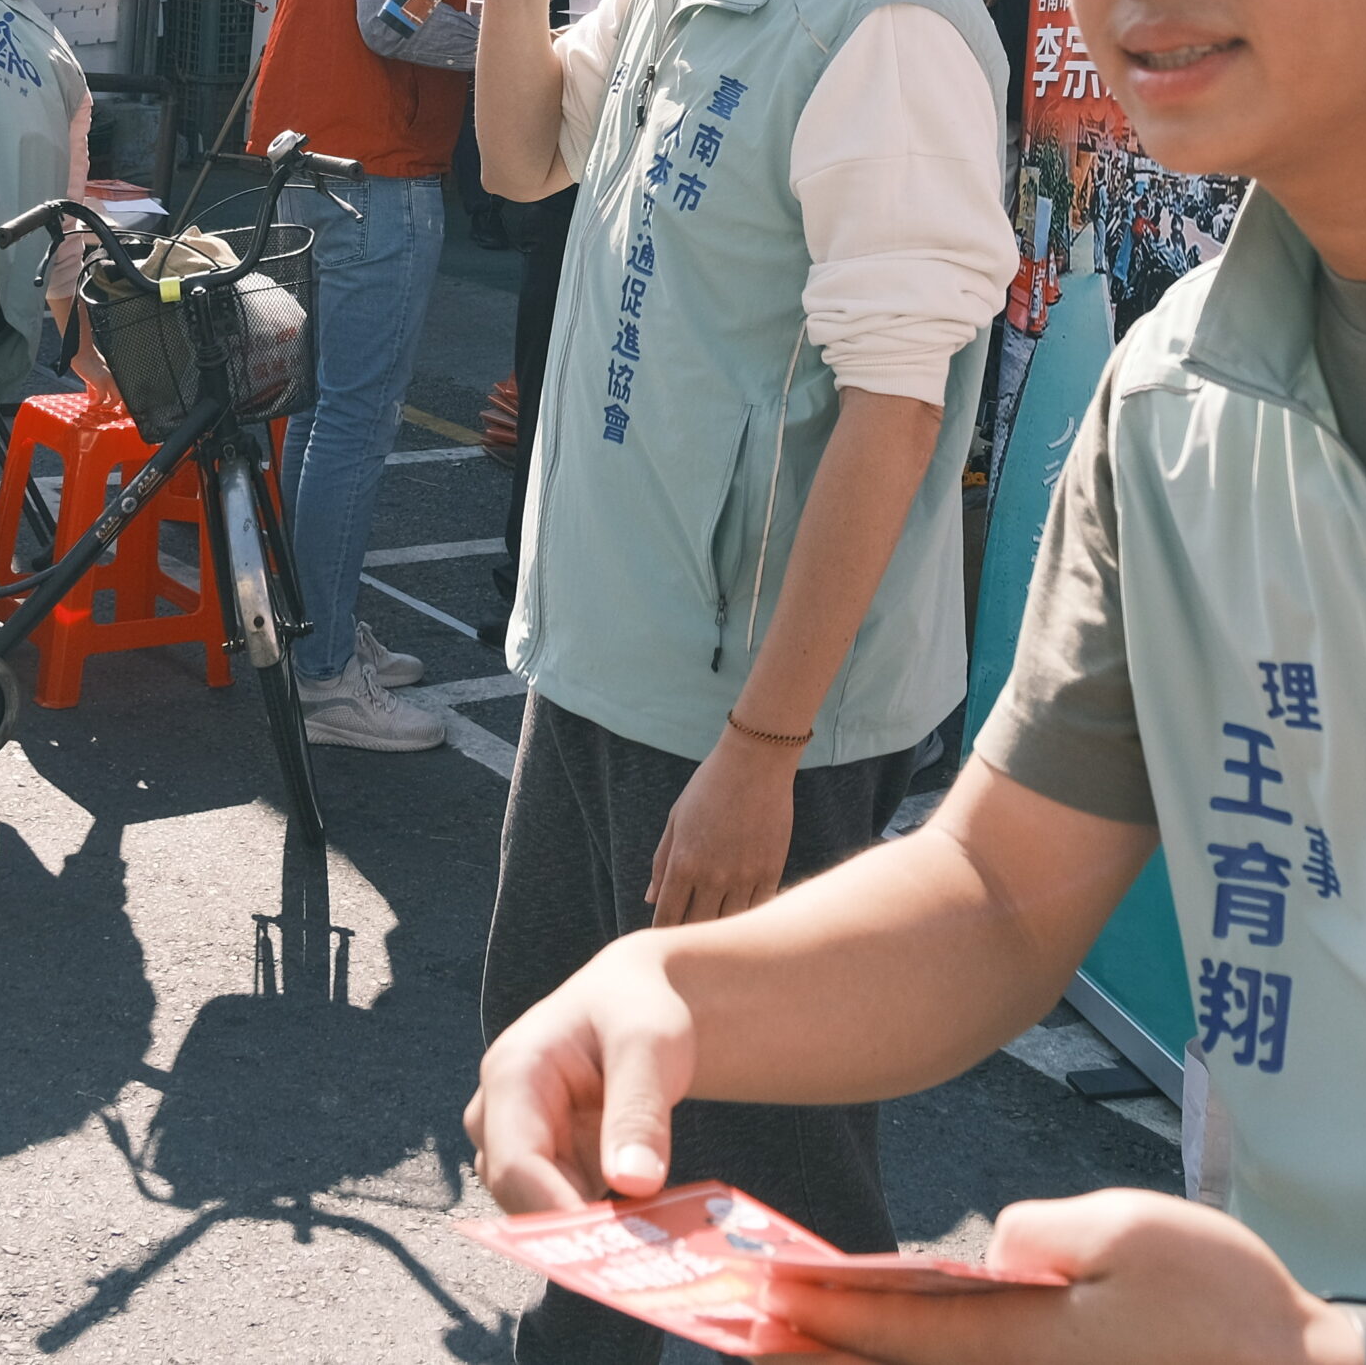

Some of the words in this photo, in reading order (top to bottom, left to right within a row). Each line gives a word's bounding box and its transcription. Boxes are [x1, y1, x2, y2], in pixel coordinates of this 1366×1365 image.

[1032, 22, 1119, 99] 李宗
[671, 74, 749, 213] 臺南市
[1198, 721, 1294, 1075] 王育翔
